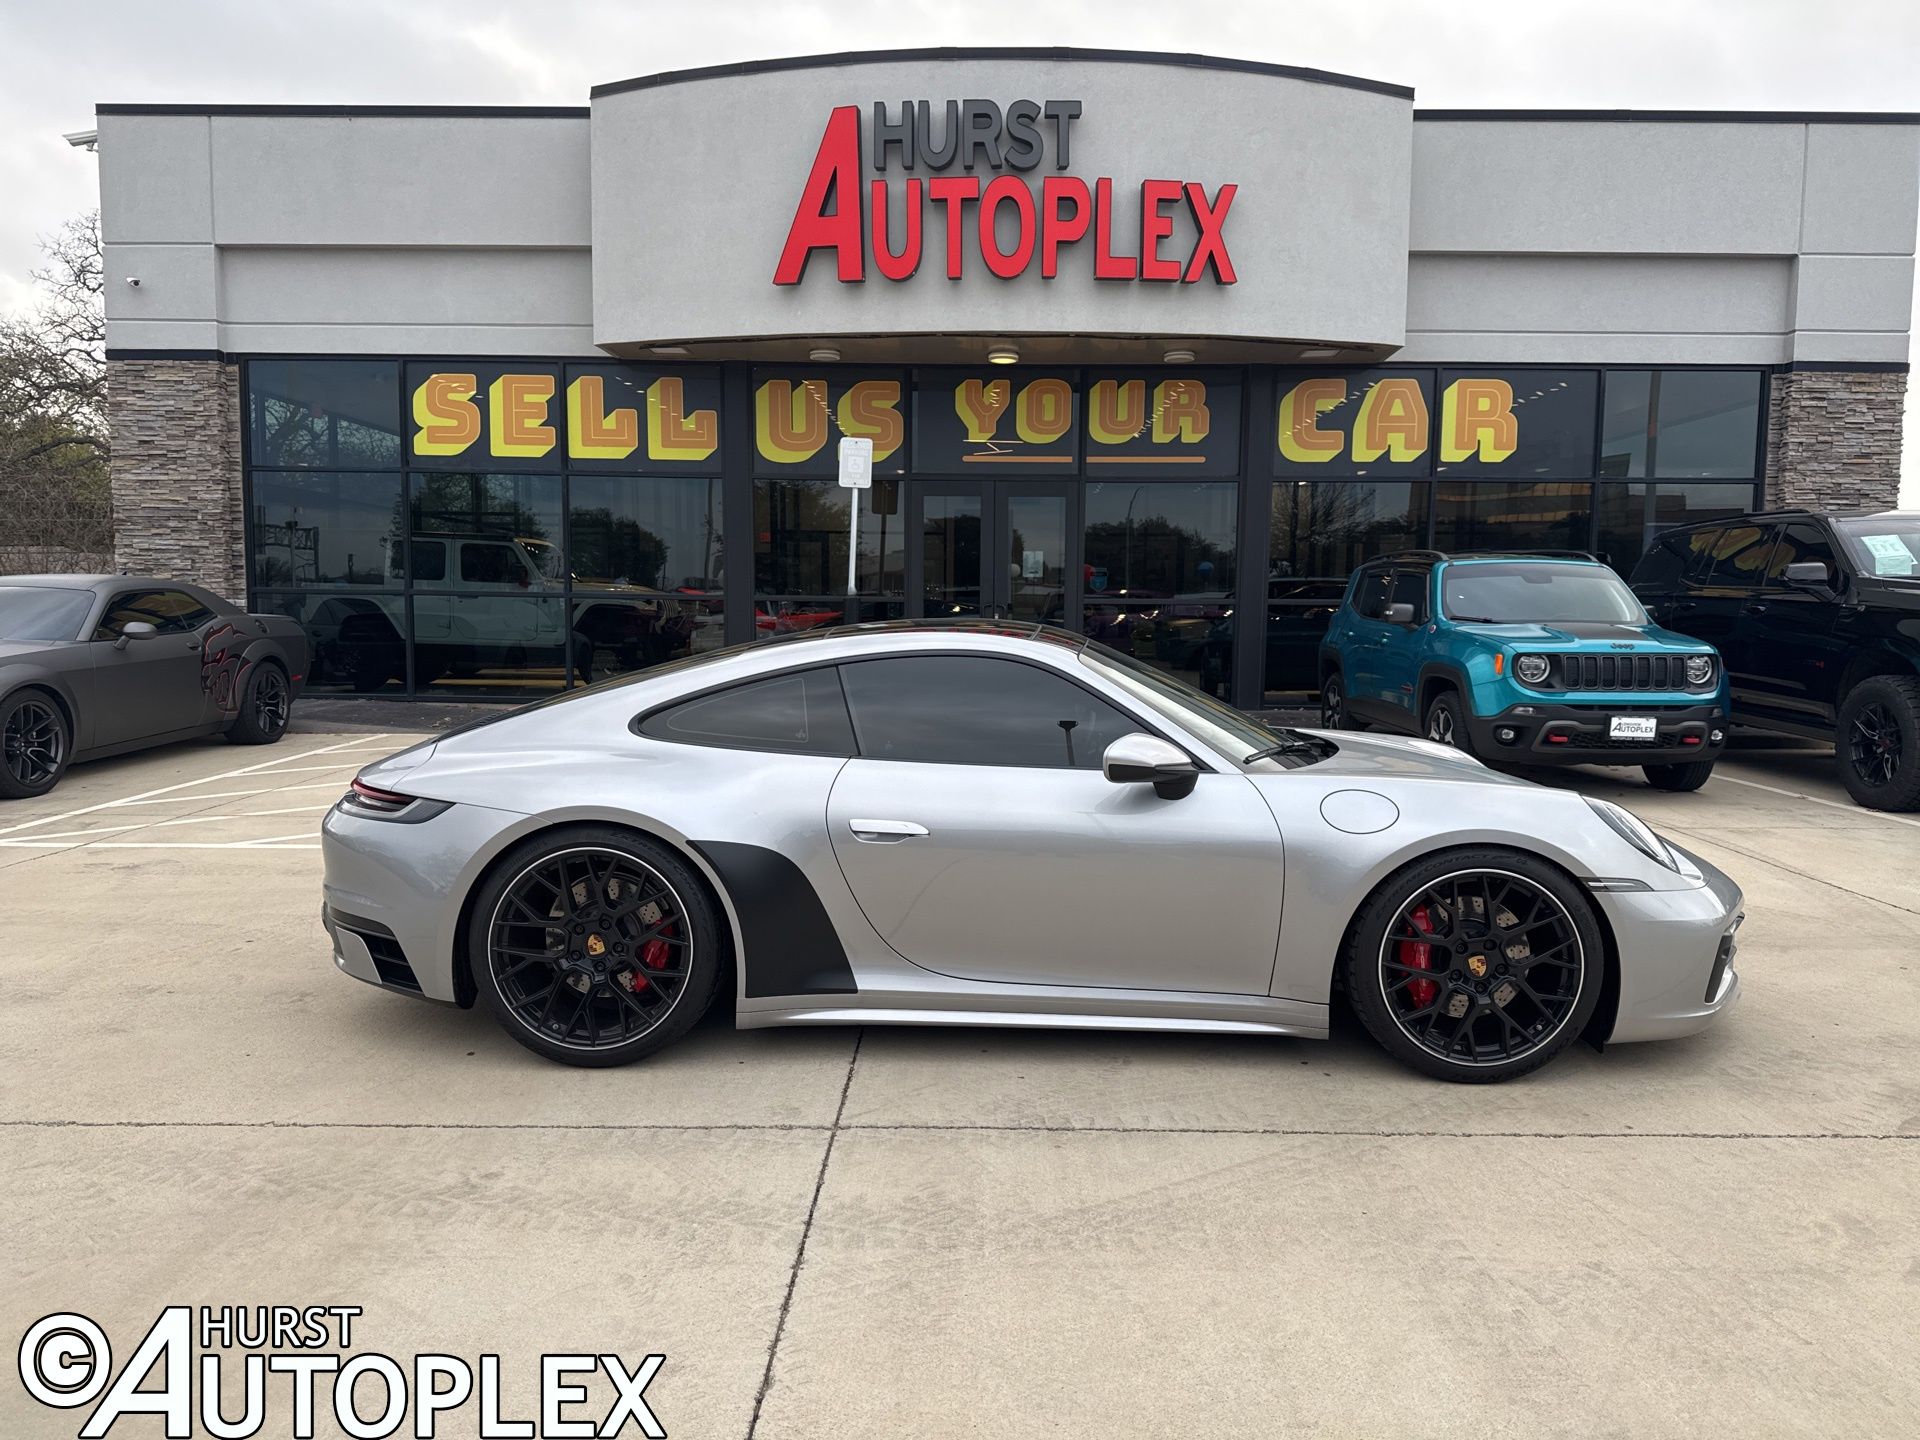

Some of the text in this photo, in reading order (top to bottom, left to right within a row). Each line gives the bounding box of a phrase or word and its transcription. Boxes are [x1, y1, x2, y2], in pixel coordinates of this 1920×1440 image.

[873, 99, 1082, 171] HURST
[773, 104, 1238, 287] AUTOPLEX
[412, 373, 1518, 464] SELL US YOUR CAR
[1611, 721, 1654, 734] AUTOPLEX
